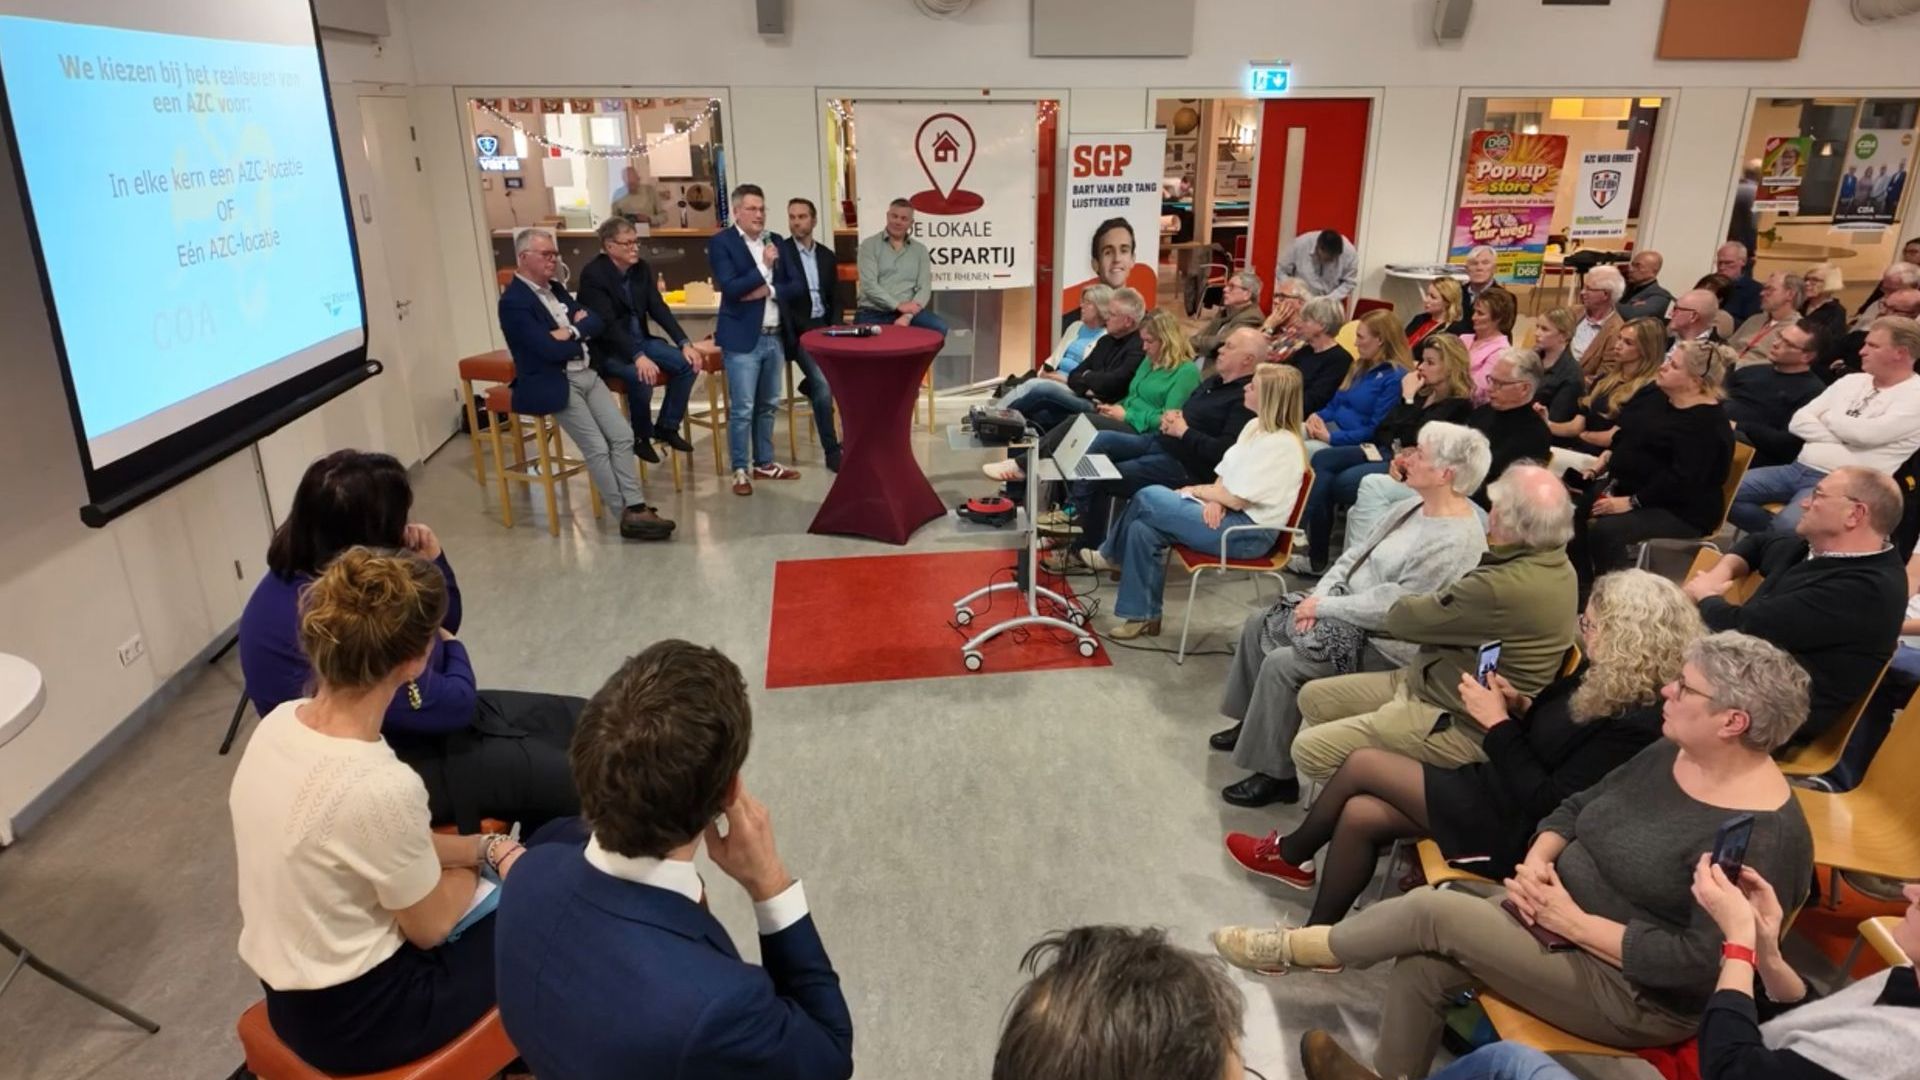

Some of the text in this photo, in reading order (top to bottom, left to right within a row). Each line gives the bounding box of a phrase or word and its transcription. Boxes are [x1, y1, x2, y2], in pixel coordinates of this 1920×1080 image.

[58, 54, 94, 80] We
[100, 57, 157, 83] kiezen
[160, 60, 181, 88] bij
[185, 62, 210, 85] het
[214, 65, 276, 87] realiseren
[153, 95, 181, 113] een
[187, 92, 215, 113] AZC
[1074, 144, 1132, 177] SGP
[109, 157, 304, 198] In elke kern een AZC-locatie
[1476, 161, 1548, 182] Pop up
[1073, 182, 1157, 195] BART VAN DER TANG
[1489, 180, 1531, 194] store
[217, 199, 234, 221] OF
[1072, 197, 1131, 208] LIJSTTREKKER
[928, 221, 992, 237] LOKALE
[1471, 214, 1492, 231] 24
[1474, 223, 1534, 240] uur weg!
[177, 228, 280, 267] Eén AZC-locatie
[928, 247, 1015, 267] KSPARTIJ
[930, 271, 990, 281] ENTE RHENEN
[1517, 267, 1538, 276] D66
